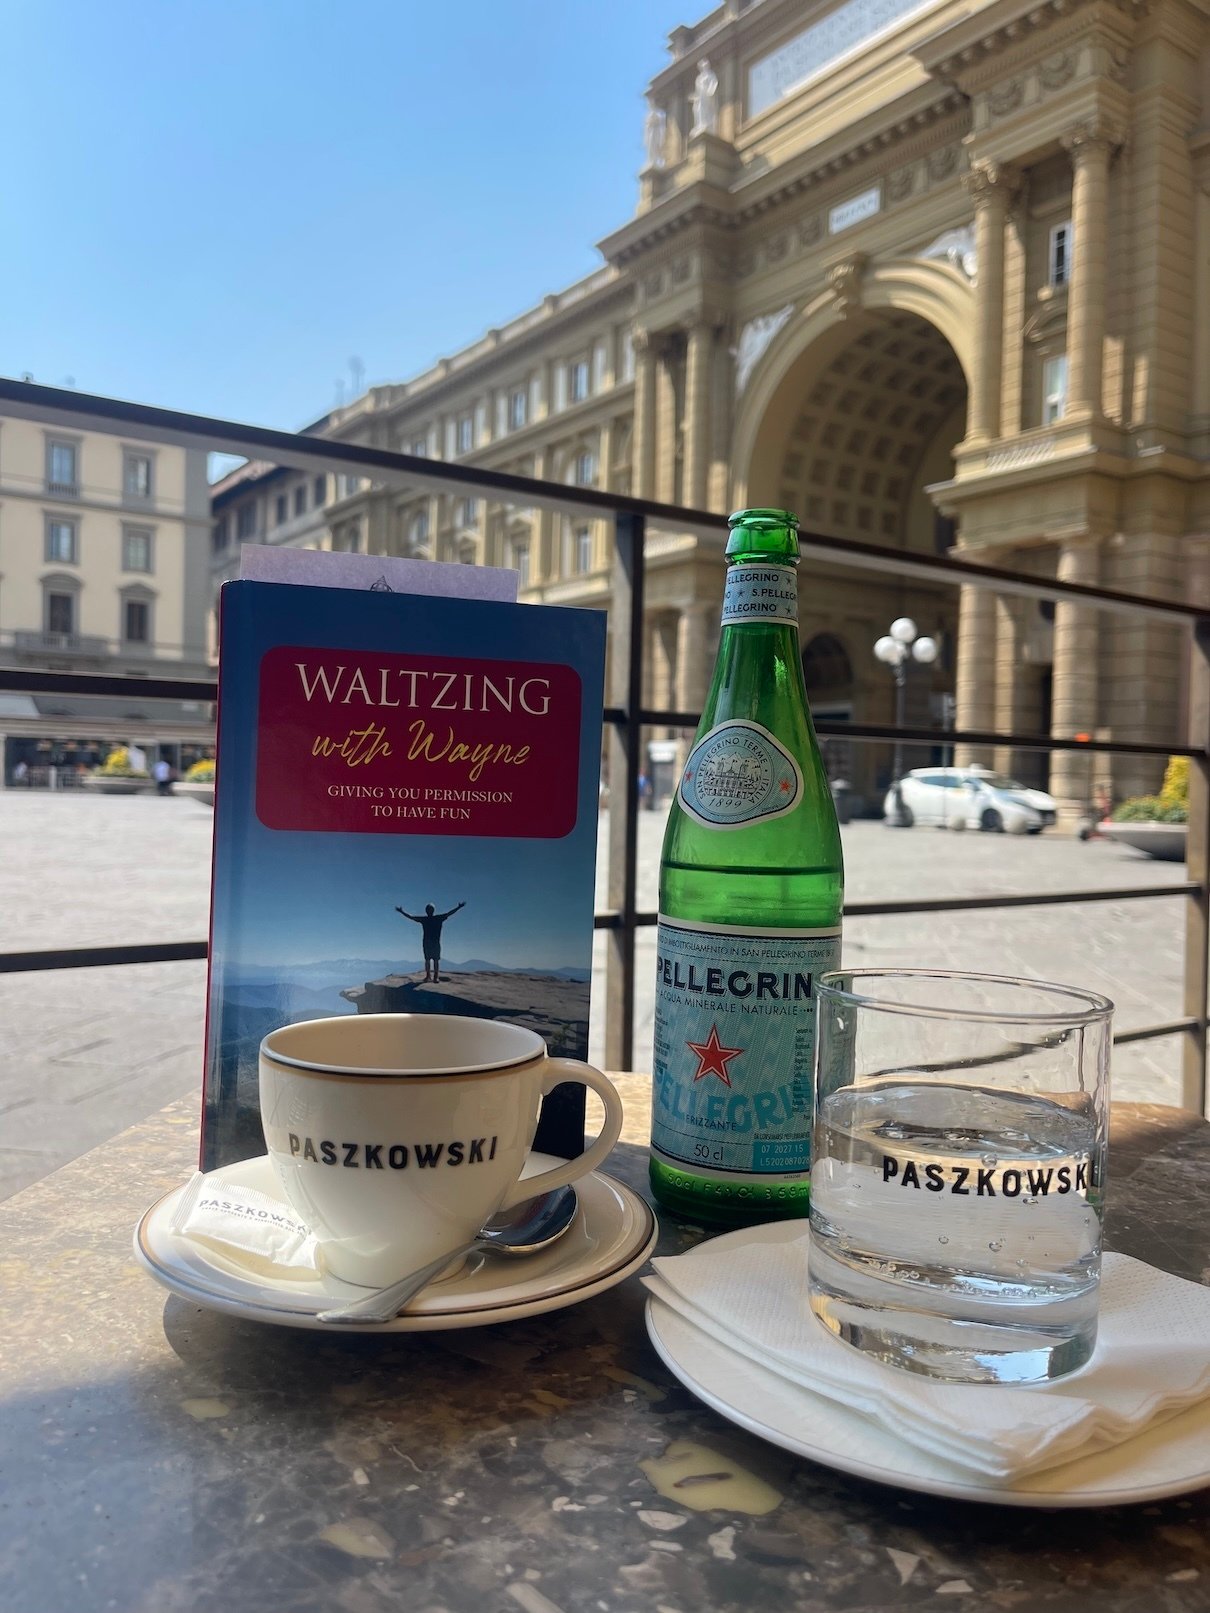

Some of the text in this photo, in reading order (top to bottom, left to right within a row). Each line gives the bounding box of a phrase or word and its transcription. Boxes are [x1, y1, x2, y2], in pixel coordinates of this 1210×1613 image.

[727, 574, 779, 585] ELLEGRINO
[294, 663, 552, 716] WALTZING
[312, 719, 531, 782] with Wayne
[697, 736, 740, 777] PELLEGRINO
[743, 739, 768, 764] TERME
[327, 785, 513, 803] GIVING YOU PERMISSION
[697, 780, 707, 800] SAN
[371, 805, 471, 820] TO HAVE FUN
[708, 797, 743, 809] 1899
[741, 948, 760, 957] SAN
[761, 949, 806, 959] PELLEGRINO
[657, 955, 815, 1002] PELLEGRIN
[684, 997, 737, 1013] MINERALE
[741, 1003, 798, 1016] NATURALE
[685, 1113, 737, 1132] FRIZZANTE
[289, 1132, 498, 1171] PASZKOWSKI
[693, 1143, 724, 1161] 50 cl
[761, 1144, 770, 1154] 07
[775, 1144, 792, 1154] 2027
